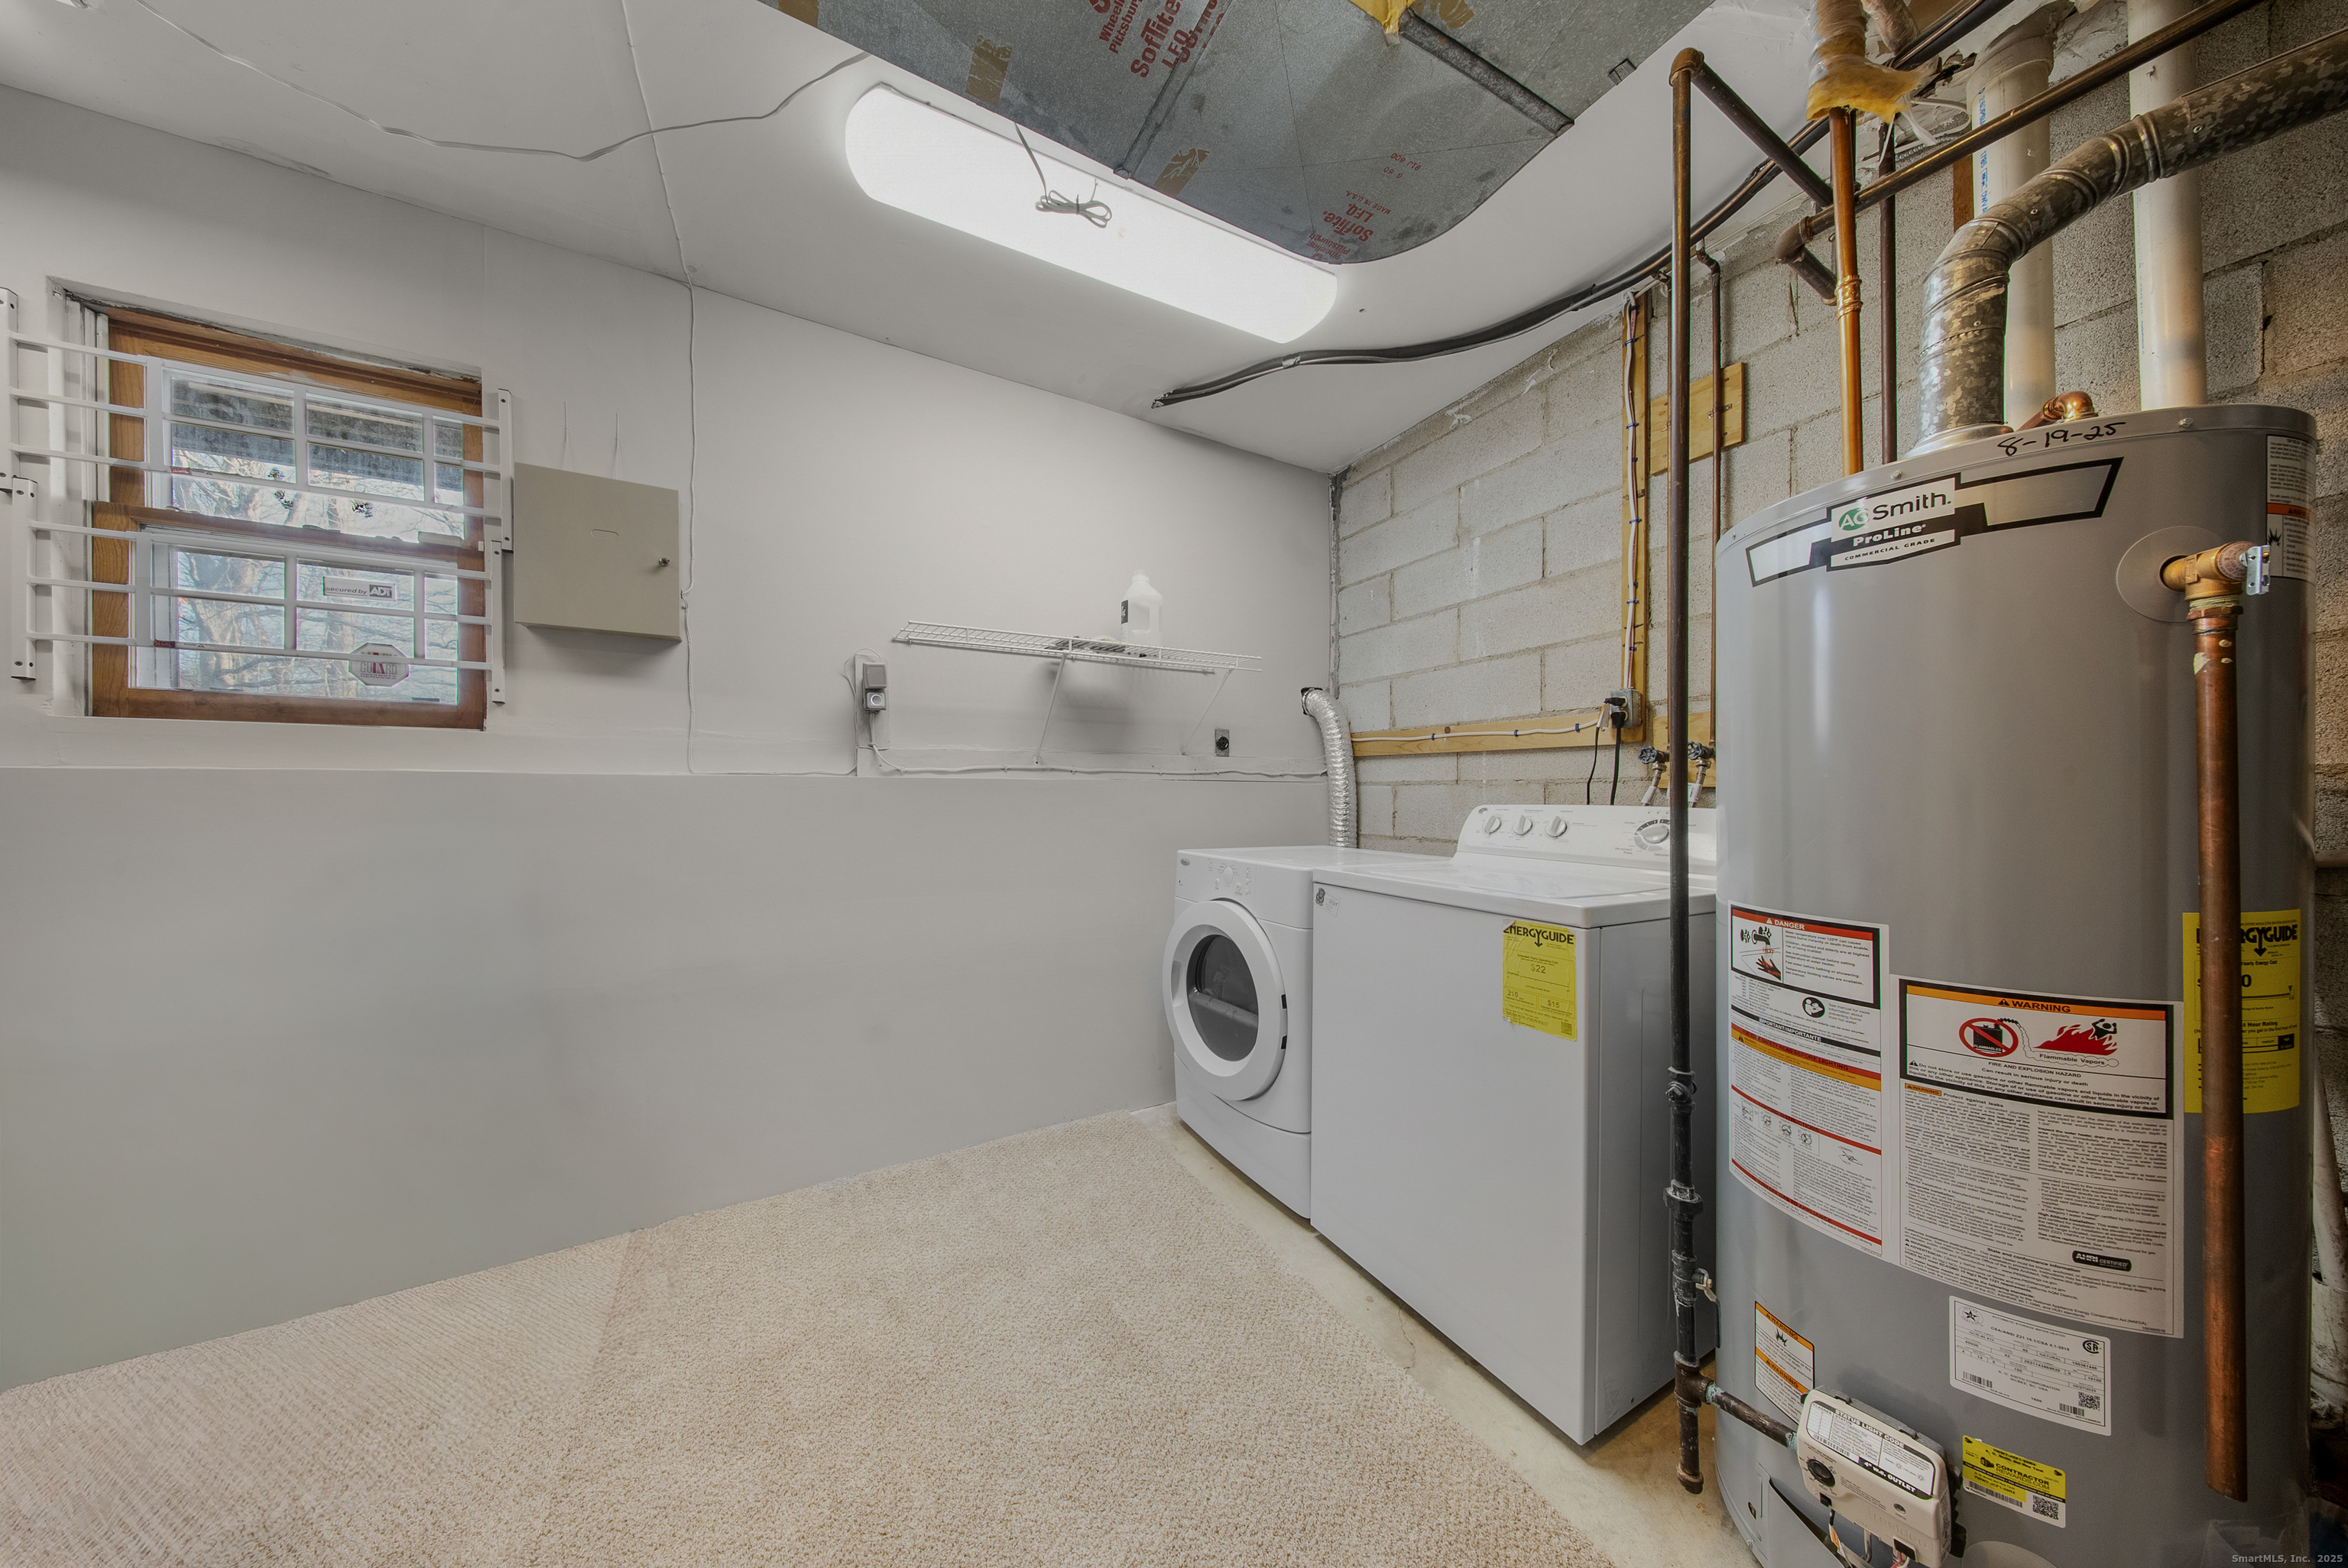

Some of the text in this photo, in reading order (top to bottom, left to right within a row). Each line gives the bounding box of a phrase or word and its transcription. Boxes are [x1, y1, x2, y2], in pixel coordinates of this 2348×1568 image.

[1372, 202, 1392, 215] MADE
[1306, 241, 1341, 260] Wheeling
[1309, 233, 1351, 254] Pittsburgh
[1997, 421, 2126, 456] 8-19-25
[1844, 537, 1936, 561] COMMERCIAL GRADE
[369, 586, 392, 597] ADT
[1774, 919, 1805, 930] DANGER
[1531, 963, 1546, 974] $22
[1507, 990, 1518, 998] 210
[1547, 999, 1560, 1008] $15
[2011, 999, 2071, 1012] WARNING
[1818, 1058, 1849, 1070] LIGHTING
[2039, 1053, 2077, 1062] Flammable
[2018, 1065, 2054, 1074] EXPLOSION
[2020, 1073, 2043, 1081] serious
[1909, 1070, 1928, 1078] liquids
[1945, 1077, 1966, 1086] vicinity
[2024, 1091, 2053, 1100] appliance
[1955, 1074, 1984, 1084] appliance.
[1986, 1080, 2009, 1089] Storage
[2046, 1090, 2071, 1098] gasoline
[1973, 1073, 1998, 1082] gasoline
[2024, 1081, 2056, 1090] flammable
[1912, 1086, 1939, 1095] WARNING
[2013, 1254, 2048, 1266] conformance
[2050, 1263, 2080, 1272] information
[1770, 1316, 1798, 1340] WARNING
[2039, 1353, 2061, 1361] NATURAL
[1770, 1362, 1798, 1388] WARNING
[2026, 1378, 2060, 1391] CORPORATION
[1835, 1409, 1905, 1449] STATUS LIGHT CODE
[1996, 1463, 2050, 1485] CONTRACTOR
[1996, 1468, 2050, 1490] REWARDS.COM
[1888, 1474, 1916, 1492] OUTLET
